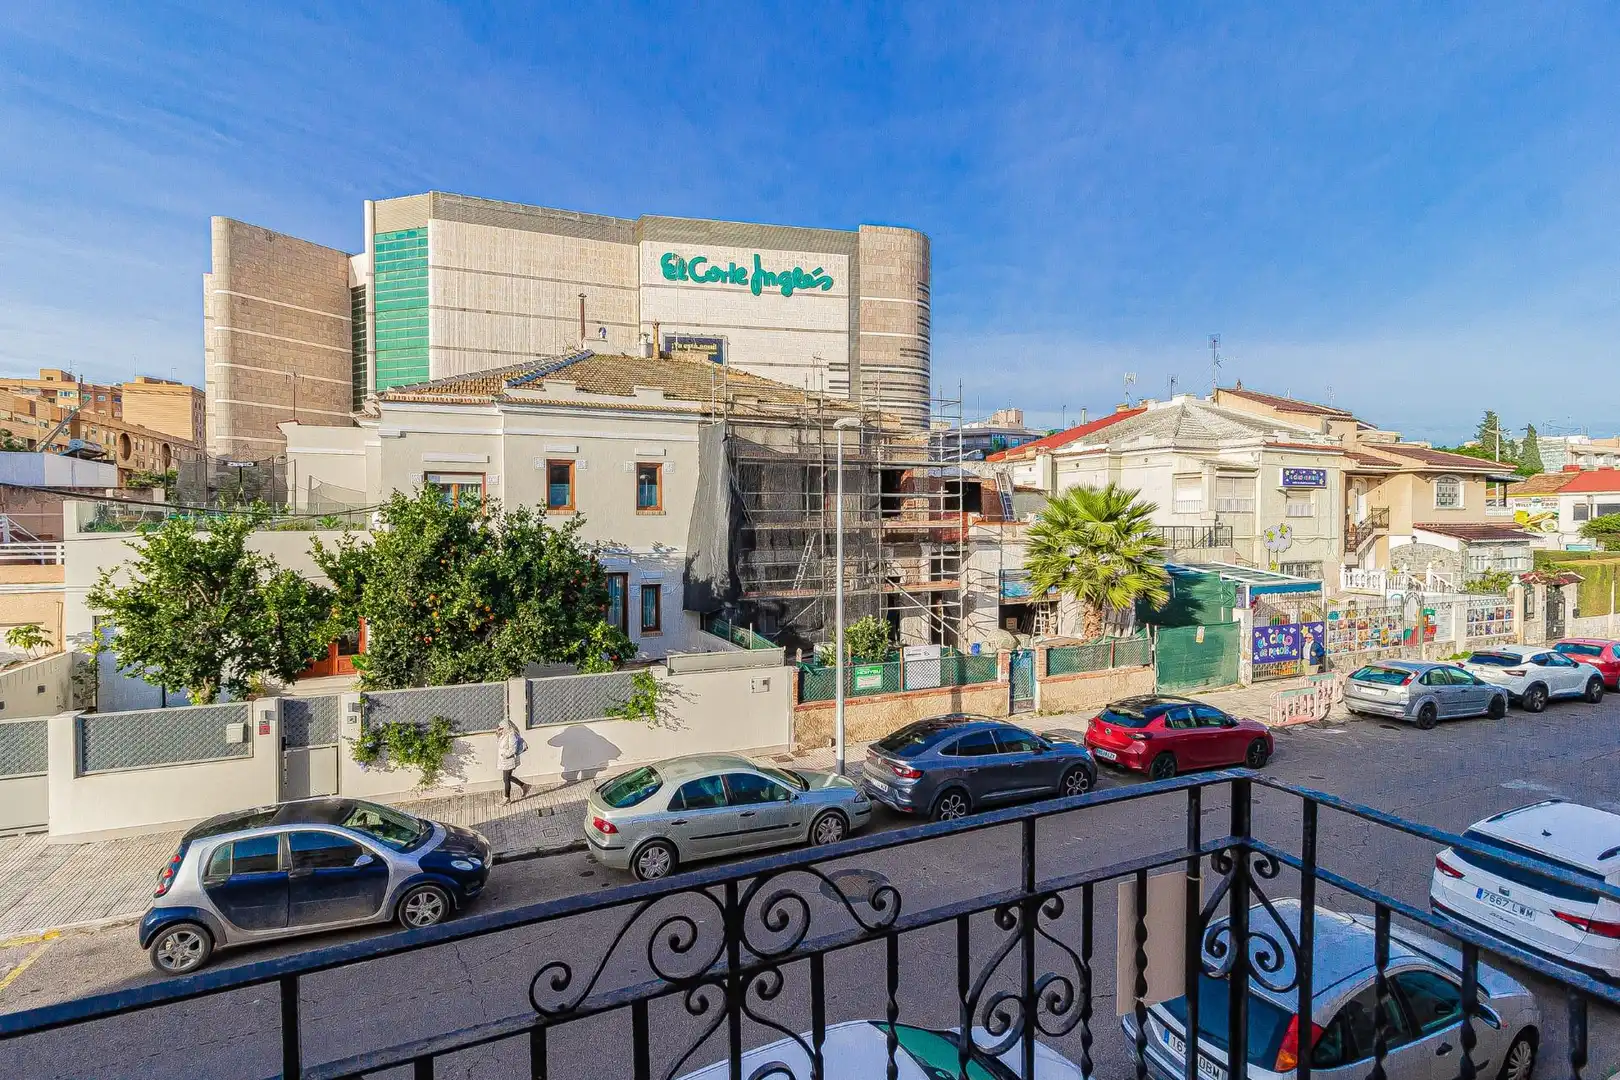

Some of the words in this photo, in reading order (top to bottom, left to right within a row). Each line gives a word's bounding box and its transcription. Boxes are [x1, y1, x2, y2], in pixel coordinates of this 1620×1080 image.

[660, 252, 688, 281] El
[687, 255, 748, 284] Corte
[750, 253, 833, 297] Inglés
[1483, 891, 1509, 907] 7667
[1511, 903, 1534, 919] LWM
